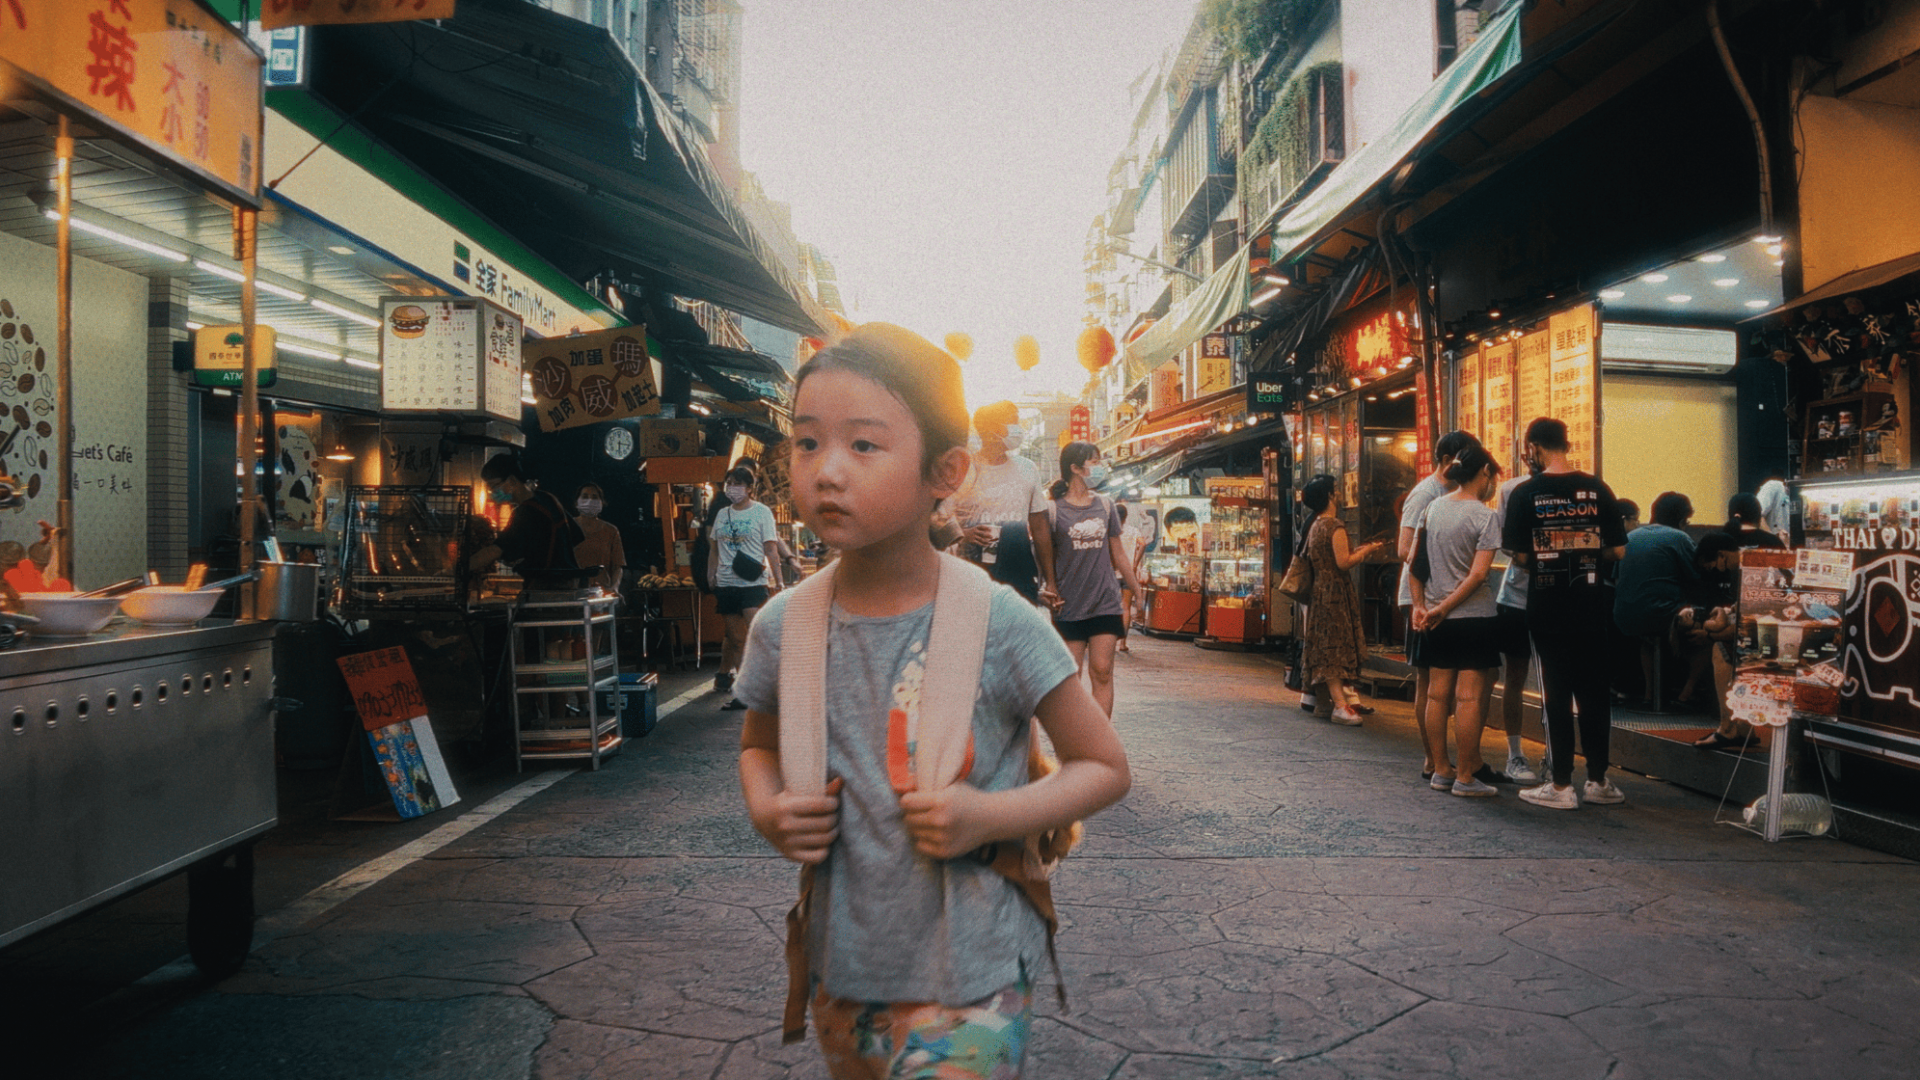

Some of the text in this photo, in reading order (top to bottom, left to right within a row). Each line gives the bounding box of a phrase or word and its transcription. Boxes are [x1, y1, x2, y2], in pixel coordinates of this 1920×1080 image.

[475, 258, 497, 298] 全家
[501, 272, 557, 332] FamilyMart
[569, 348, 604, 367] 加蛋
[223, 372, 244, 381] ATM
[621, 380, 659, 412] 加起士
[1256, 382, 1283, 393] Uber
[1256, 393, 1283, 403] Eats
[547, 397, 576, 428] 加肉
[107, 443, 133, 464] Café
[1534, 498, 1572, 507] BASKETBALL
[1535, 502, 1599, 519] SEASON
[1072, 539, 1104, 550] Roots
[1832, 527, 1877, 550] THAI
